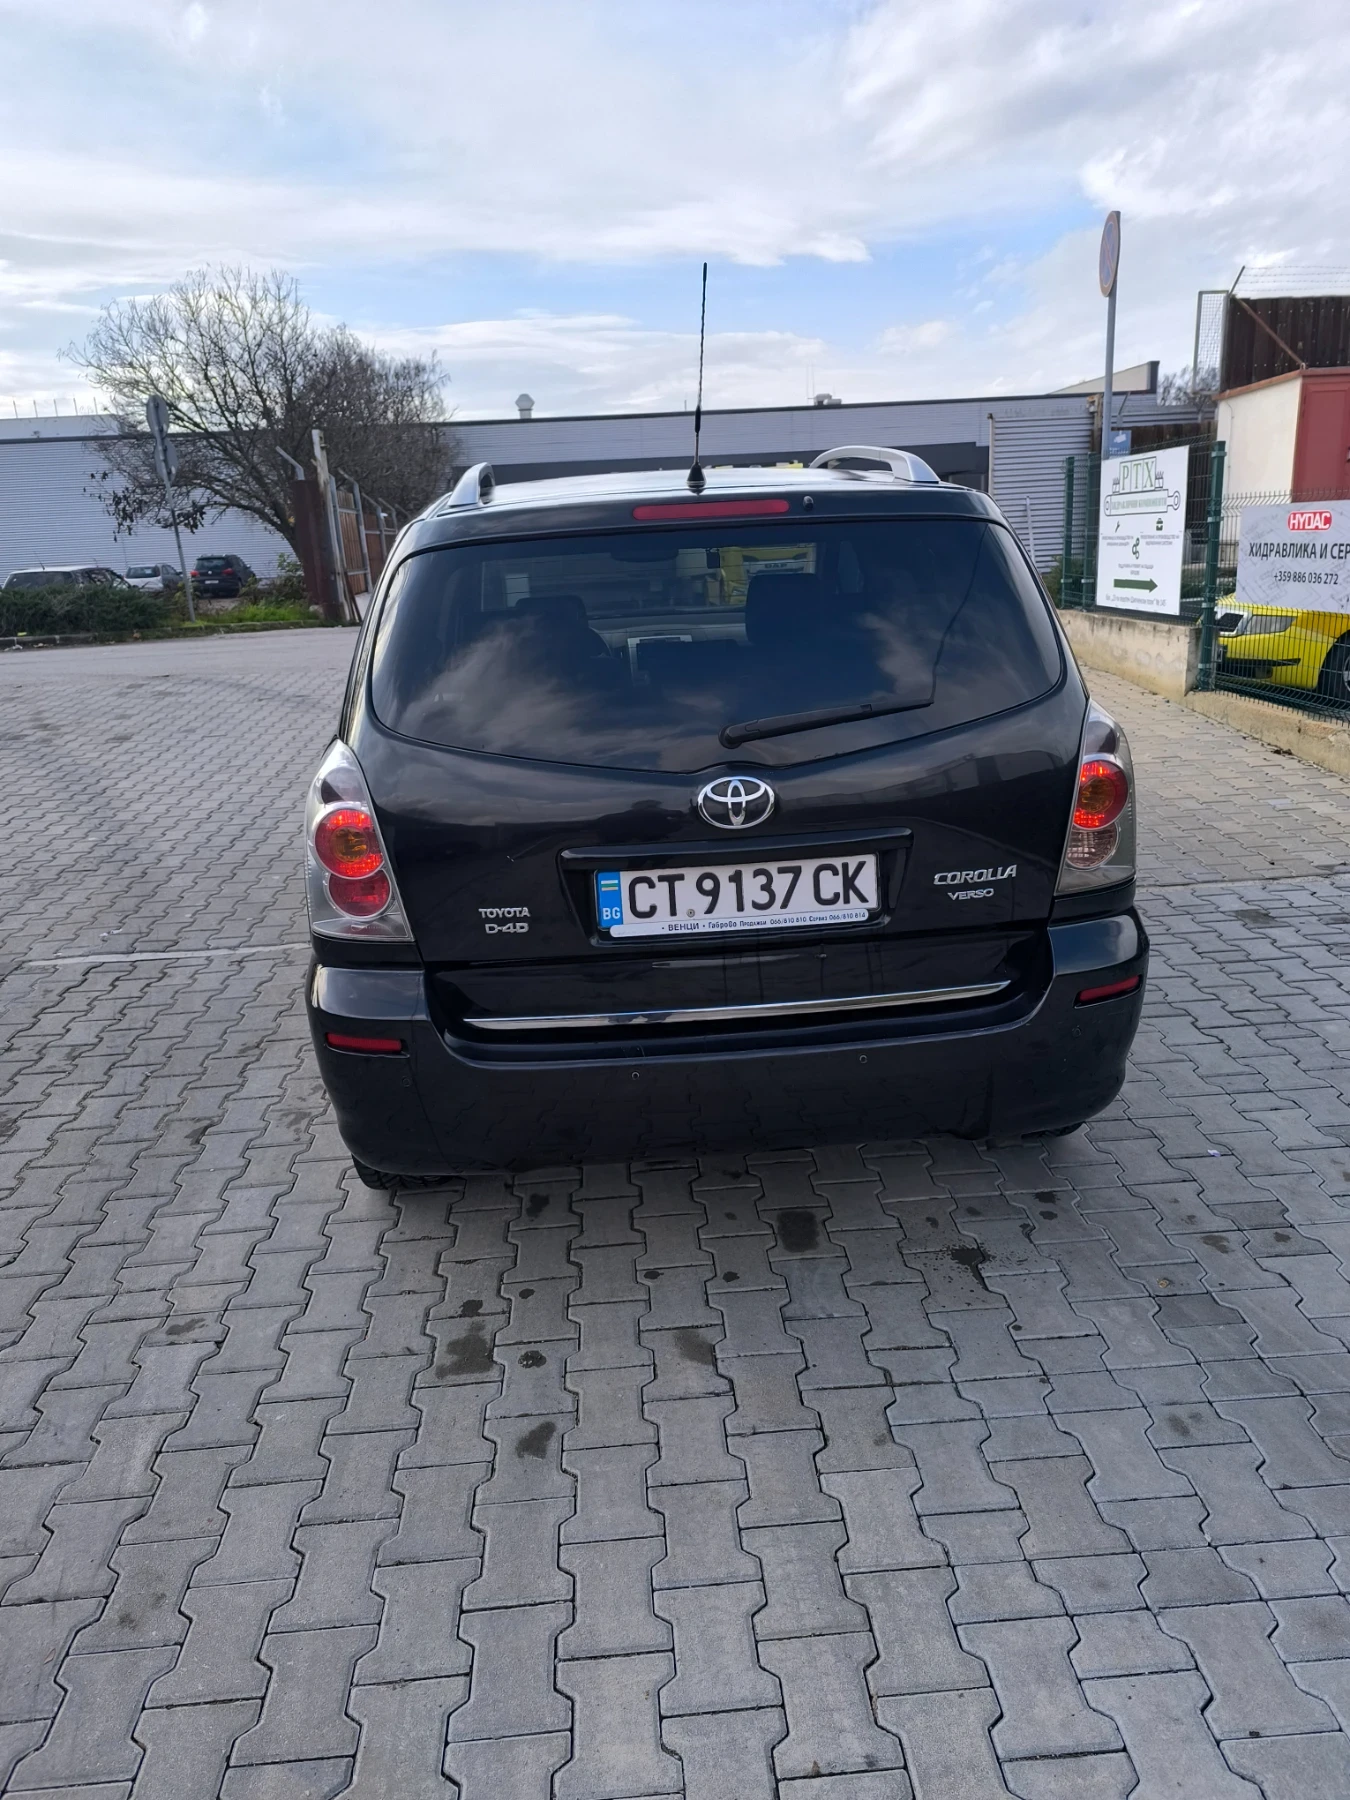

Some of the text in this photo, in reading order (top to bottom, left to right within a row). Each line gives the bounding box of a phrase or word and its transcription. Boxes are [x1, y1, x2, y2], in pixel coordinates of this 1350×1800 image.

[1289, 512, 1331, 530] HYDAC
[1248, 542, 1317, 560] ХИДРАВЛИКА
[1319, 543, 1328, 559] И
[1274, 570, 1339, 585] +359 886 036 272
[933, 864, 1018, 885] COROLLA
[628, 860, 870, 919] CT 9137 CK
[947, 888, 995, 901] VERSO
[478, 906, 531, 919] TOYOTA
[602, 907, 621, 920] BG
[485, 922, 530, 934] D-4D
[668, 922, 700, 932] ВЕНЦИ
